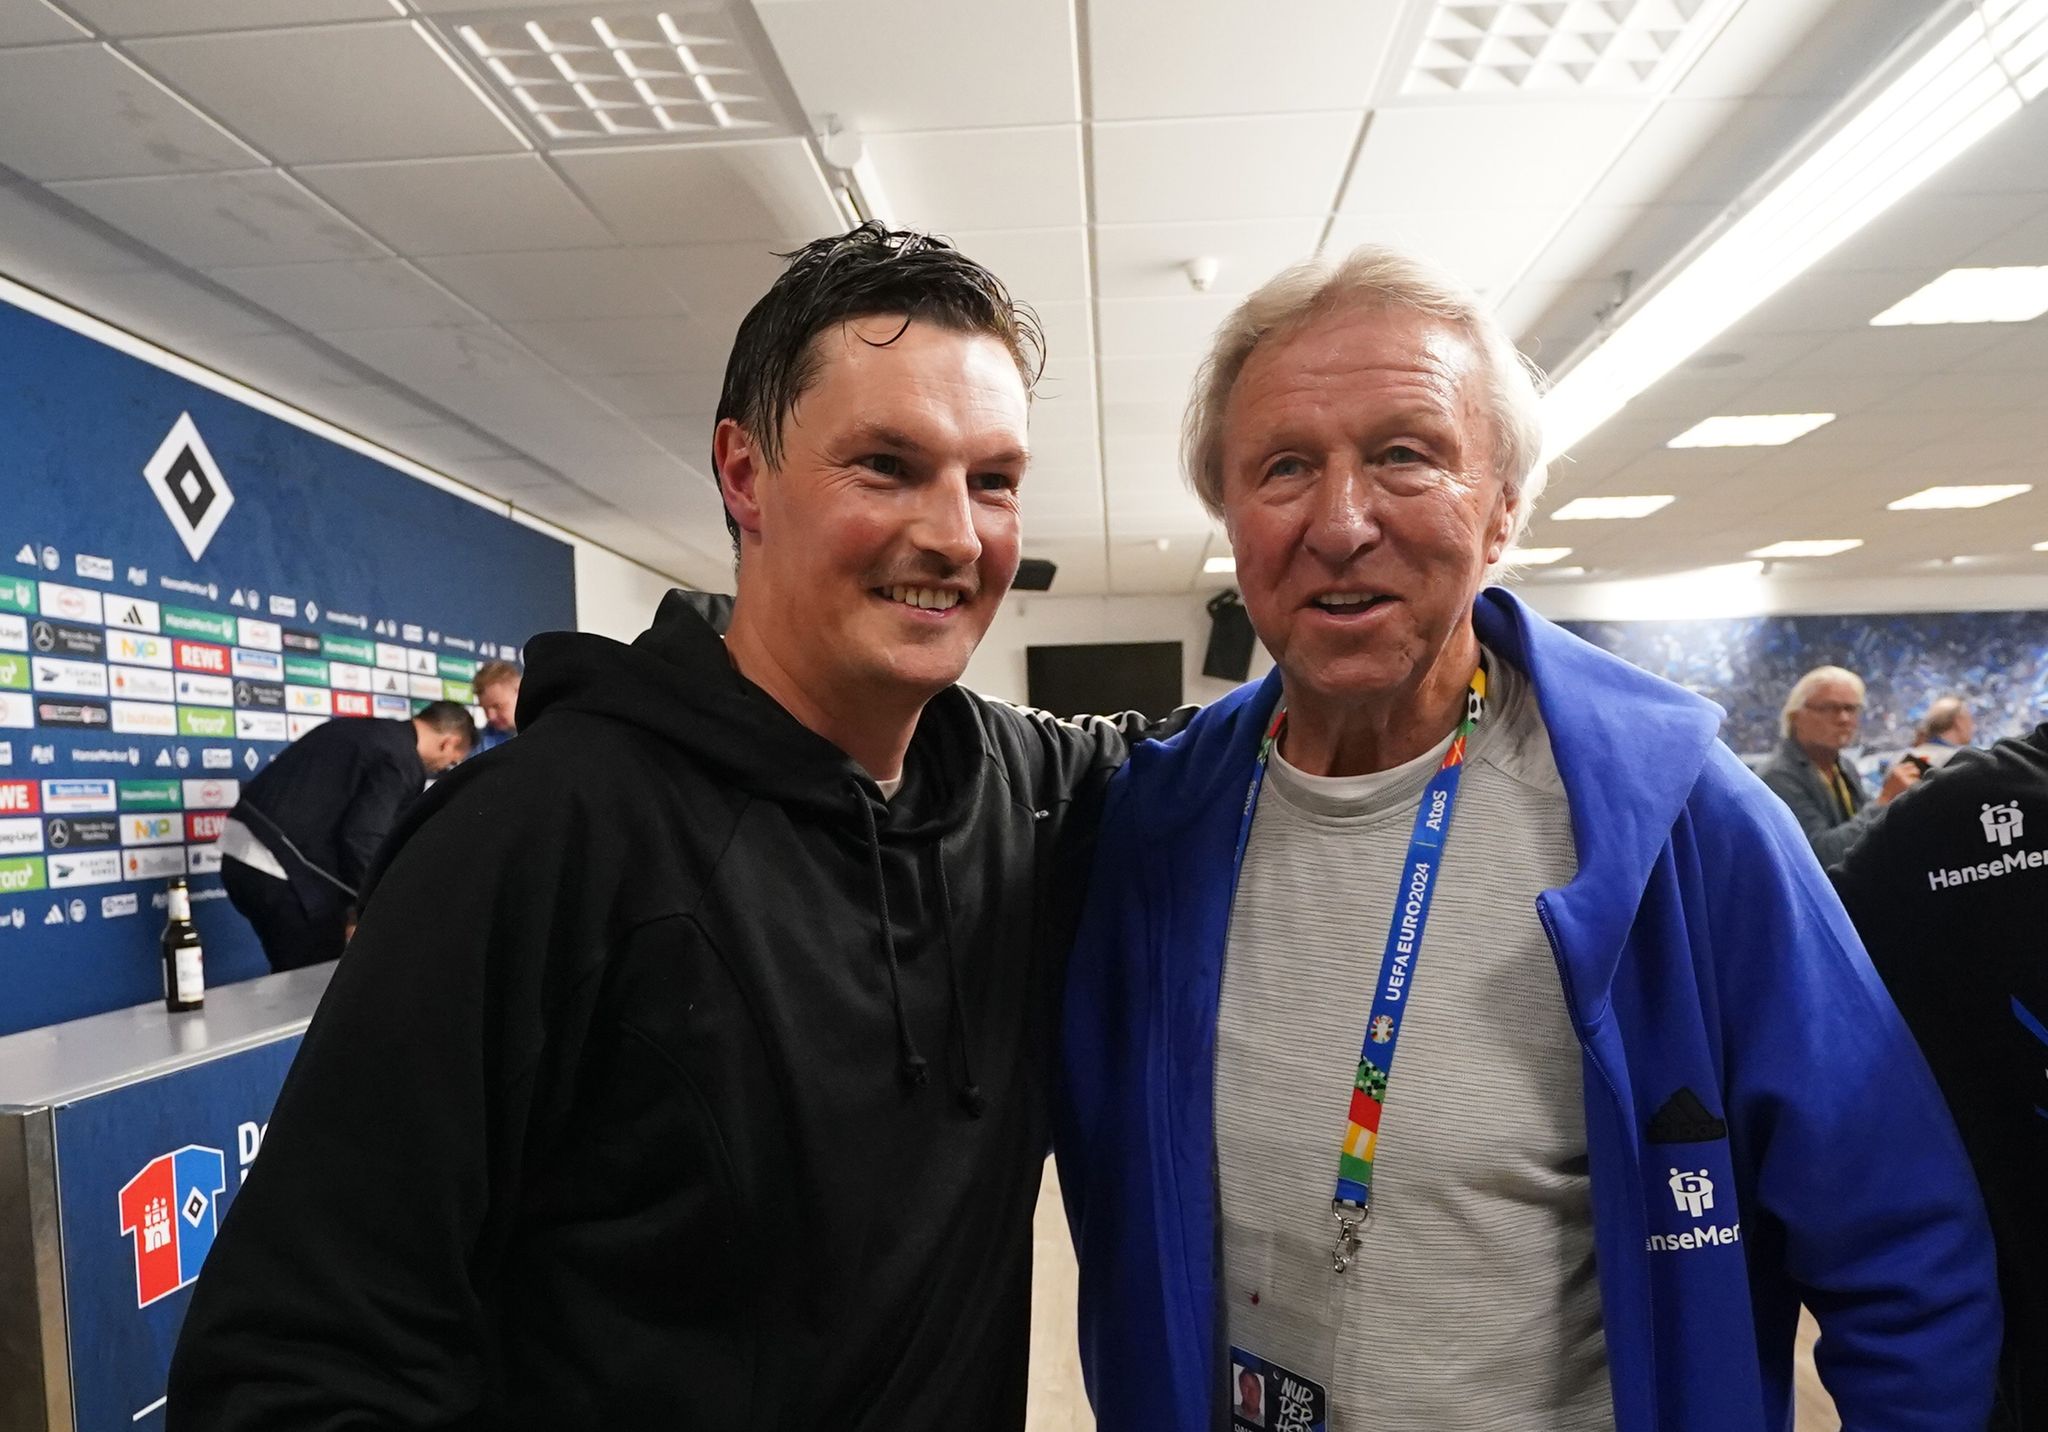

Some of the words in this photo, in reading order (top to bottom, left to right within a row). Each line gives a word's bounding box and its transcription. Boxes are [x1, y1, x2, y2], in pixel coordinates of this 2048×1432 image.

[121, 638, 158, 657] NXP
[181, 644, 225, 672] REWE
[134, 818, 170, 841] NXP
[1281, 1377, 1314, 1411] NUR
